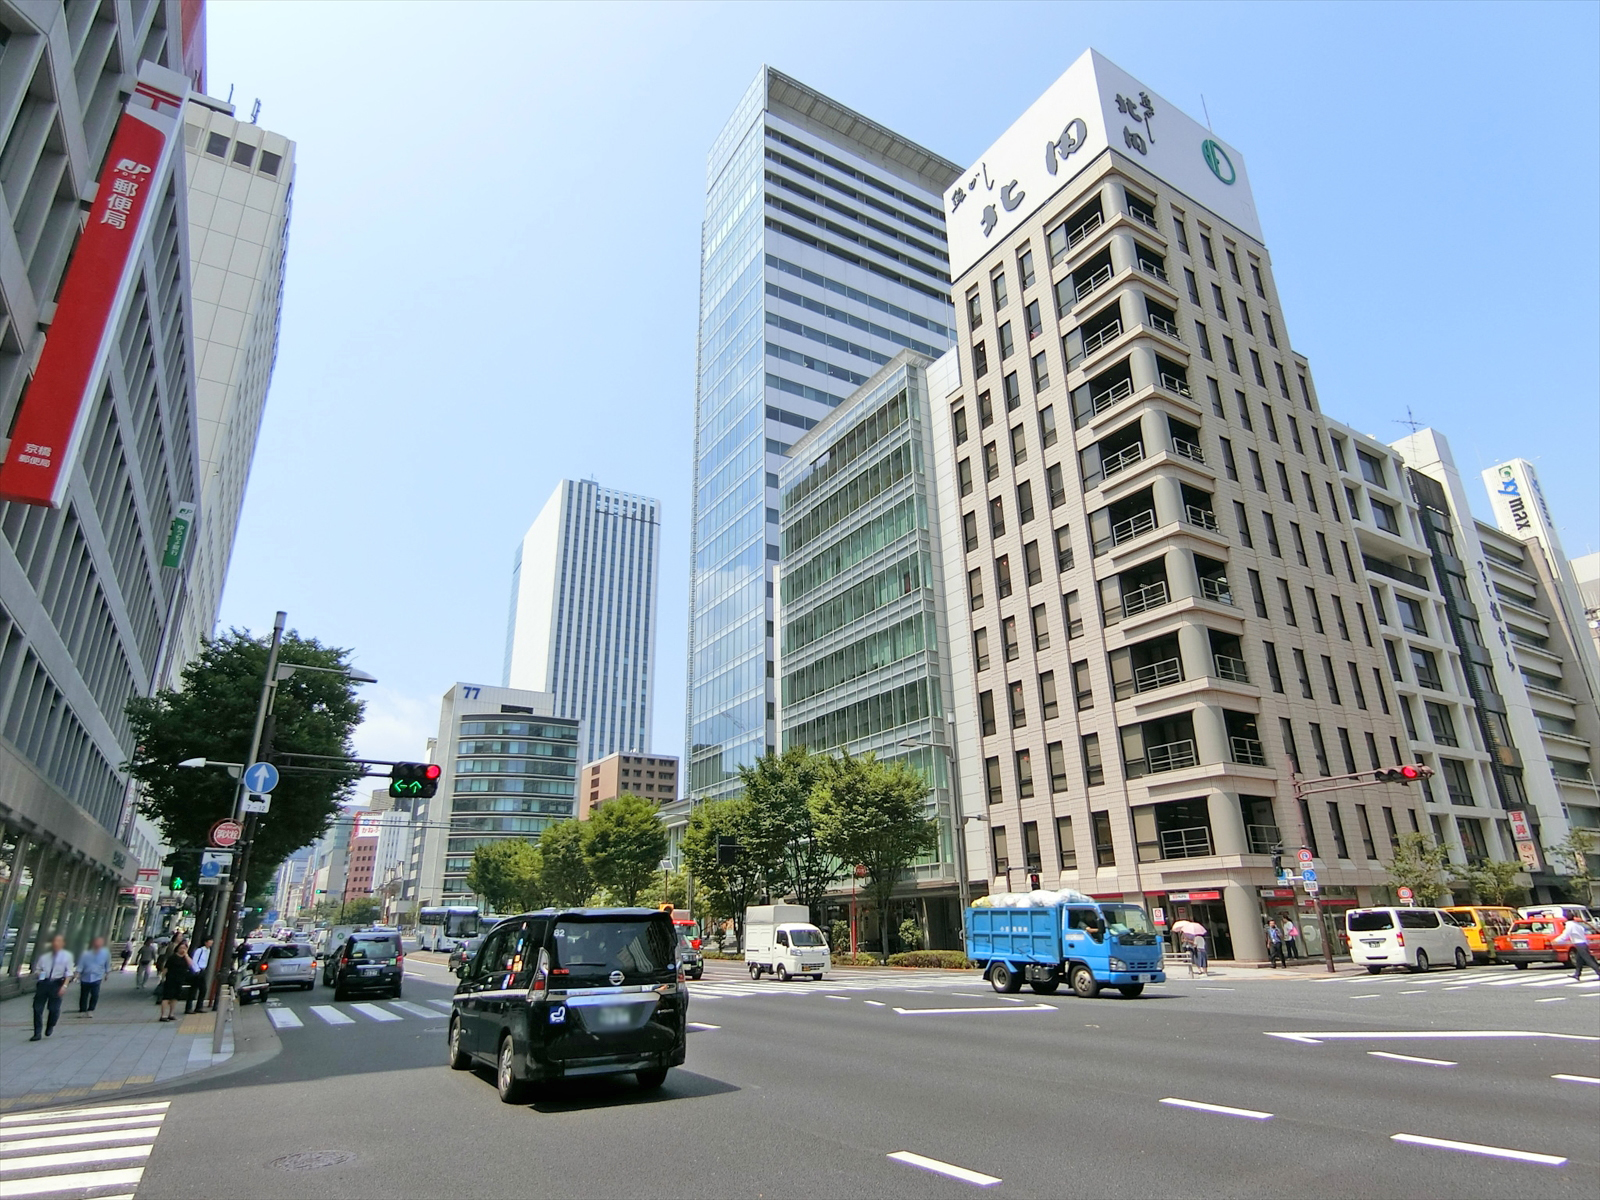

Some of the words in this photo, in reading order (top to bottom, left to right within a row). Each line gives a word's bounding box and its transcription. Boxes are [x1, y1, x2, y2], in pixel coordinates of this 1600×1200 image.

[100, 177, 139, 230] 郵便局
[463, 686, 481, 700] 77
[553, 928, 566, 938] 82
